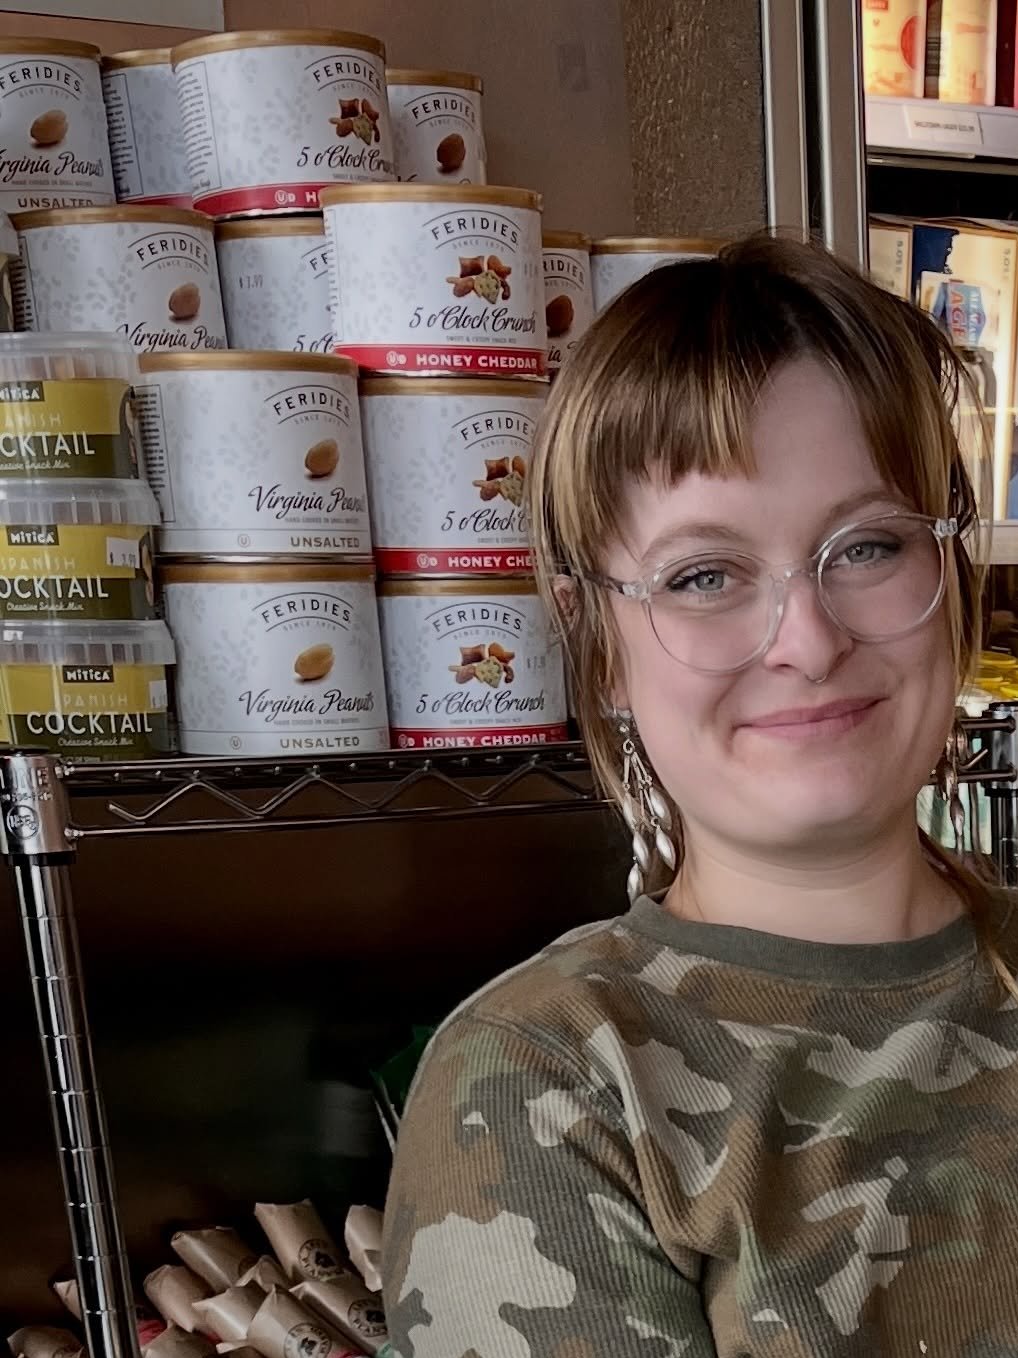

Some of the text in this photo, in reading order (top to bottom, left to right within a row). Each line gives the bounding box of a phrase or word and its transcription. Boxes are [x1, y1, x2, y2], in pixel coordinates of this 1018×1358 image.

[313, 61, 382, 92] FERIDIES
[412, 99, 476, 123] FERIDIES
[297, 146, 310, 168] 5
[431, 217, 521, 246] FERIDIES
[409, 306, 421, 329] 5
[490, 307, 536, 334] Crunch
[416, 354, 539, 369] HONEY CHEDDAR
[273, 391, 352, 420] FERIDIES
[460, 417, 530, 442] FERIDIE
[248, 484, 324, 520] Virginia
[441, 511, 453, 532] 5
[290, 537, 360, 549] UNSALTED
[448, 556, 502, 568] HONEY
[261, 599, 351, 625] FERIDIES
[432, 608, 523, 633] FERIDIES
[61, 694, 129, 708] PANISH
[239, 688, 376, 722] Virginia Peanuts
[416, 694, 428, 713] 5
[494, 690, 545, 714] Crunch
[26, 711, 153, 735] COCKTAIL
[280, 736, 360, 749] UNSALTED
[423, 733, 547, 748] HONEY CHEDDAR
